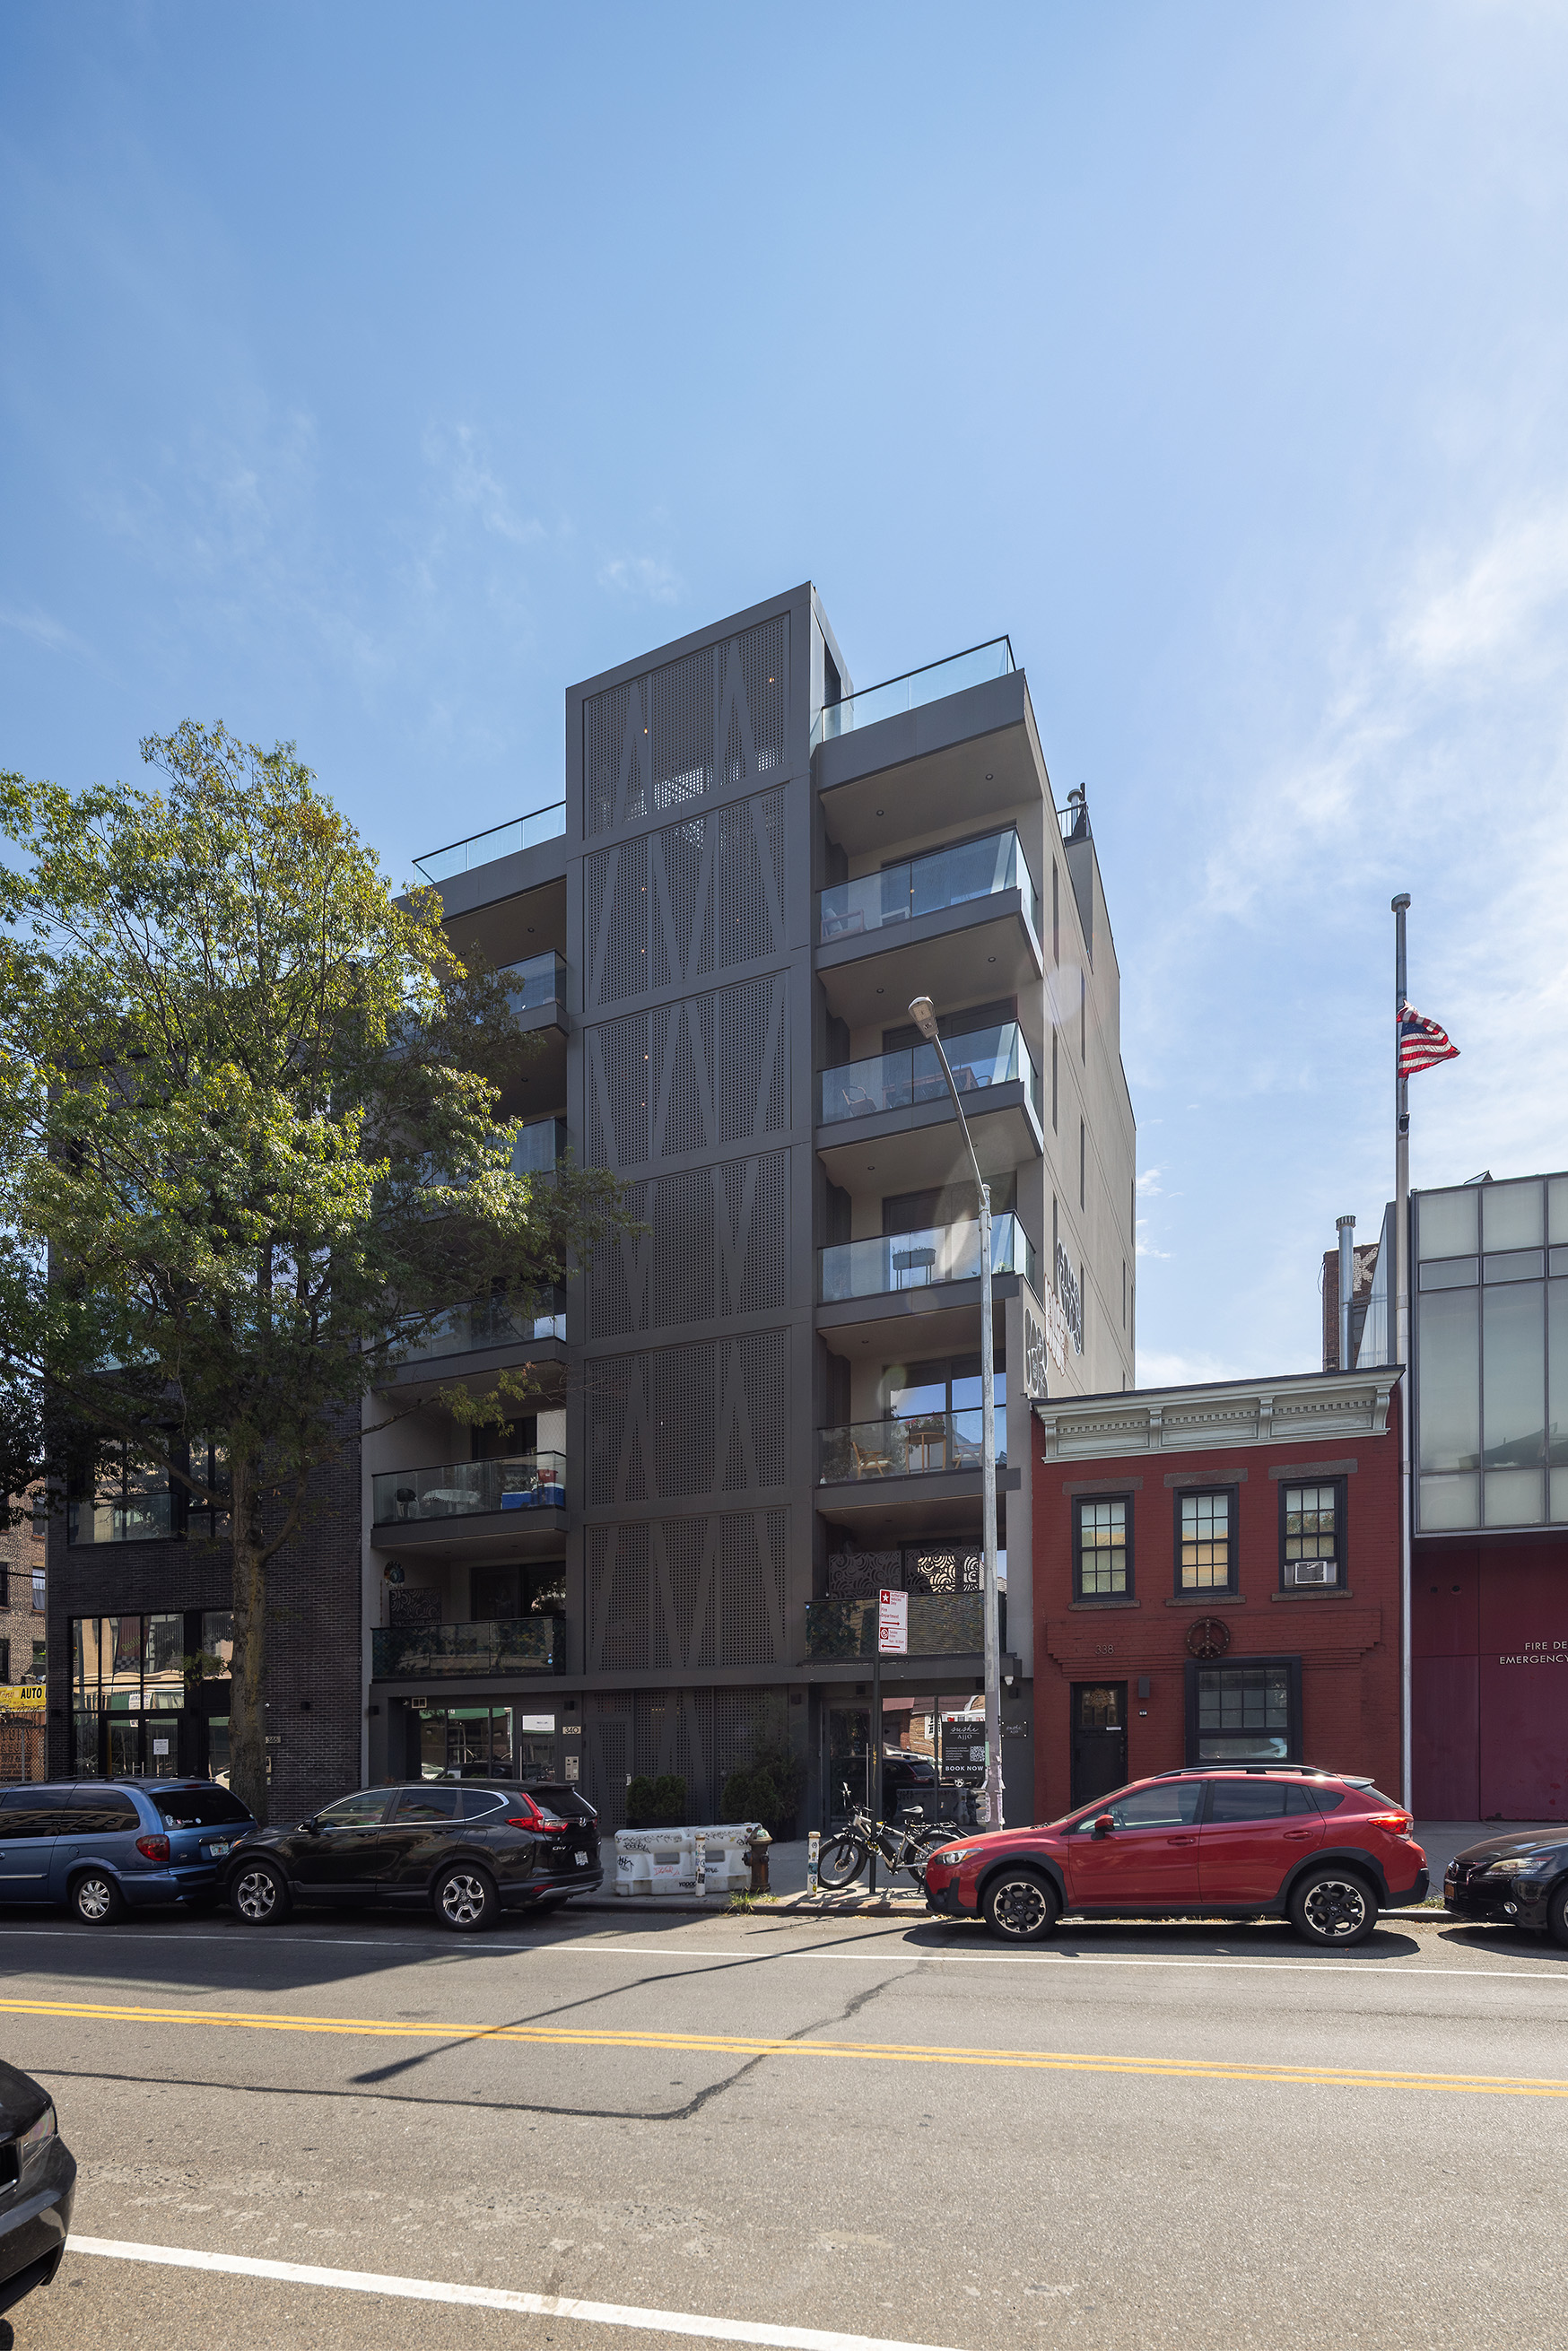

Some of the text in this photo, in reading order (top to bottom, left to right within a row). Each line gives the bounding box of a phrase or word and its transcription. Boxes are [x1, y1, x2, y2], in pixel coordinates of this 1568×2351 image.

[1094, 1644, 1115, 1654] 338
[1525, 1641, 1568, 1650] FIRE DE
[21, 1687, 42, 1699] AUTO
